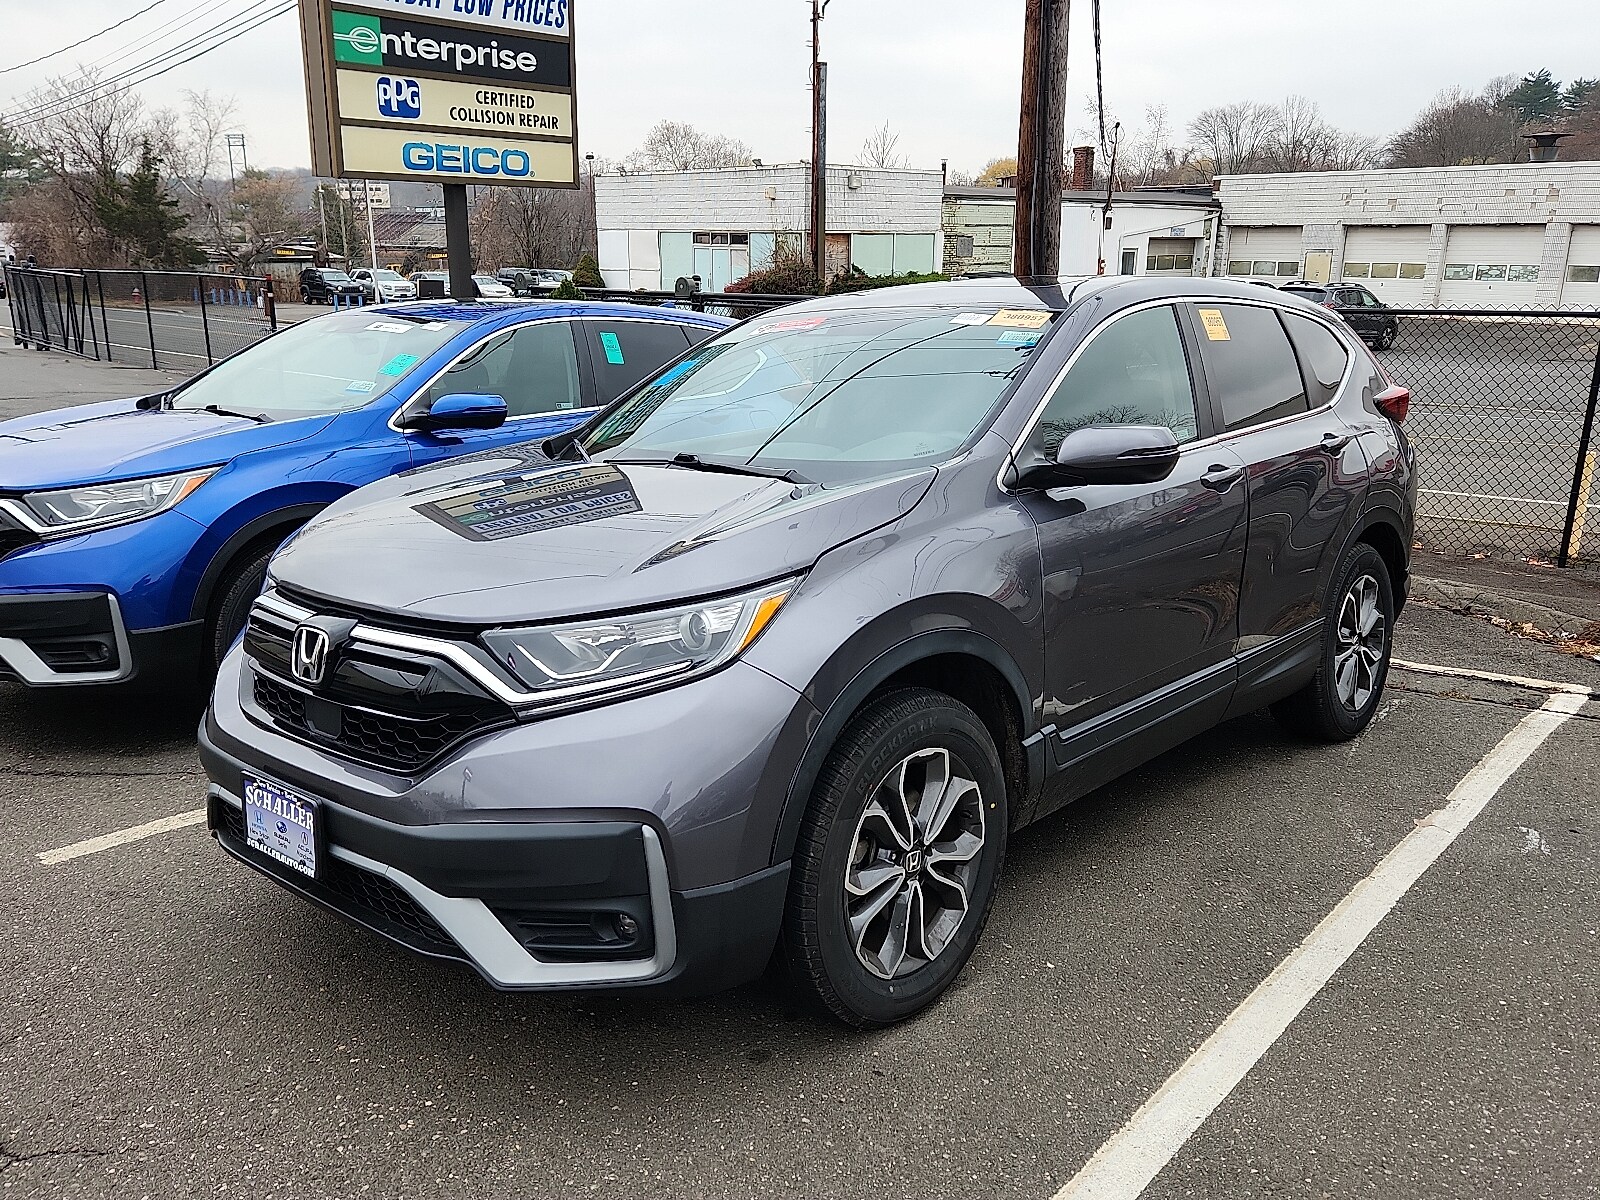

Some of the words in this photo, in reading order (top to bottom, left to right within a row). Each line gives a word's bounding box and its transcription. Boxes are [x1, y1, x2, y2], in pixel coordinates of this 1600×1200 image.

[502, 0, 568, 29] PRICES
[334, 26, 538, 73] enterprise
[378, 77, 420, 112] PPG
[475, 90, 535, 109] CERTIFIED
[450, 107, 515, 126] COLLISION
[519, 113, 560, 130] REPAIR
[402, 142, 531, 177] GEICO
[245, 784, 314, 831] SCHALLER
[246, 836, 315, 879] SCHALLERAUTO.COM
